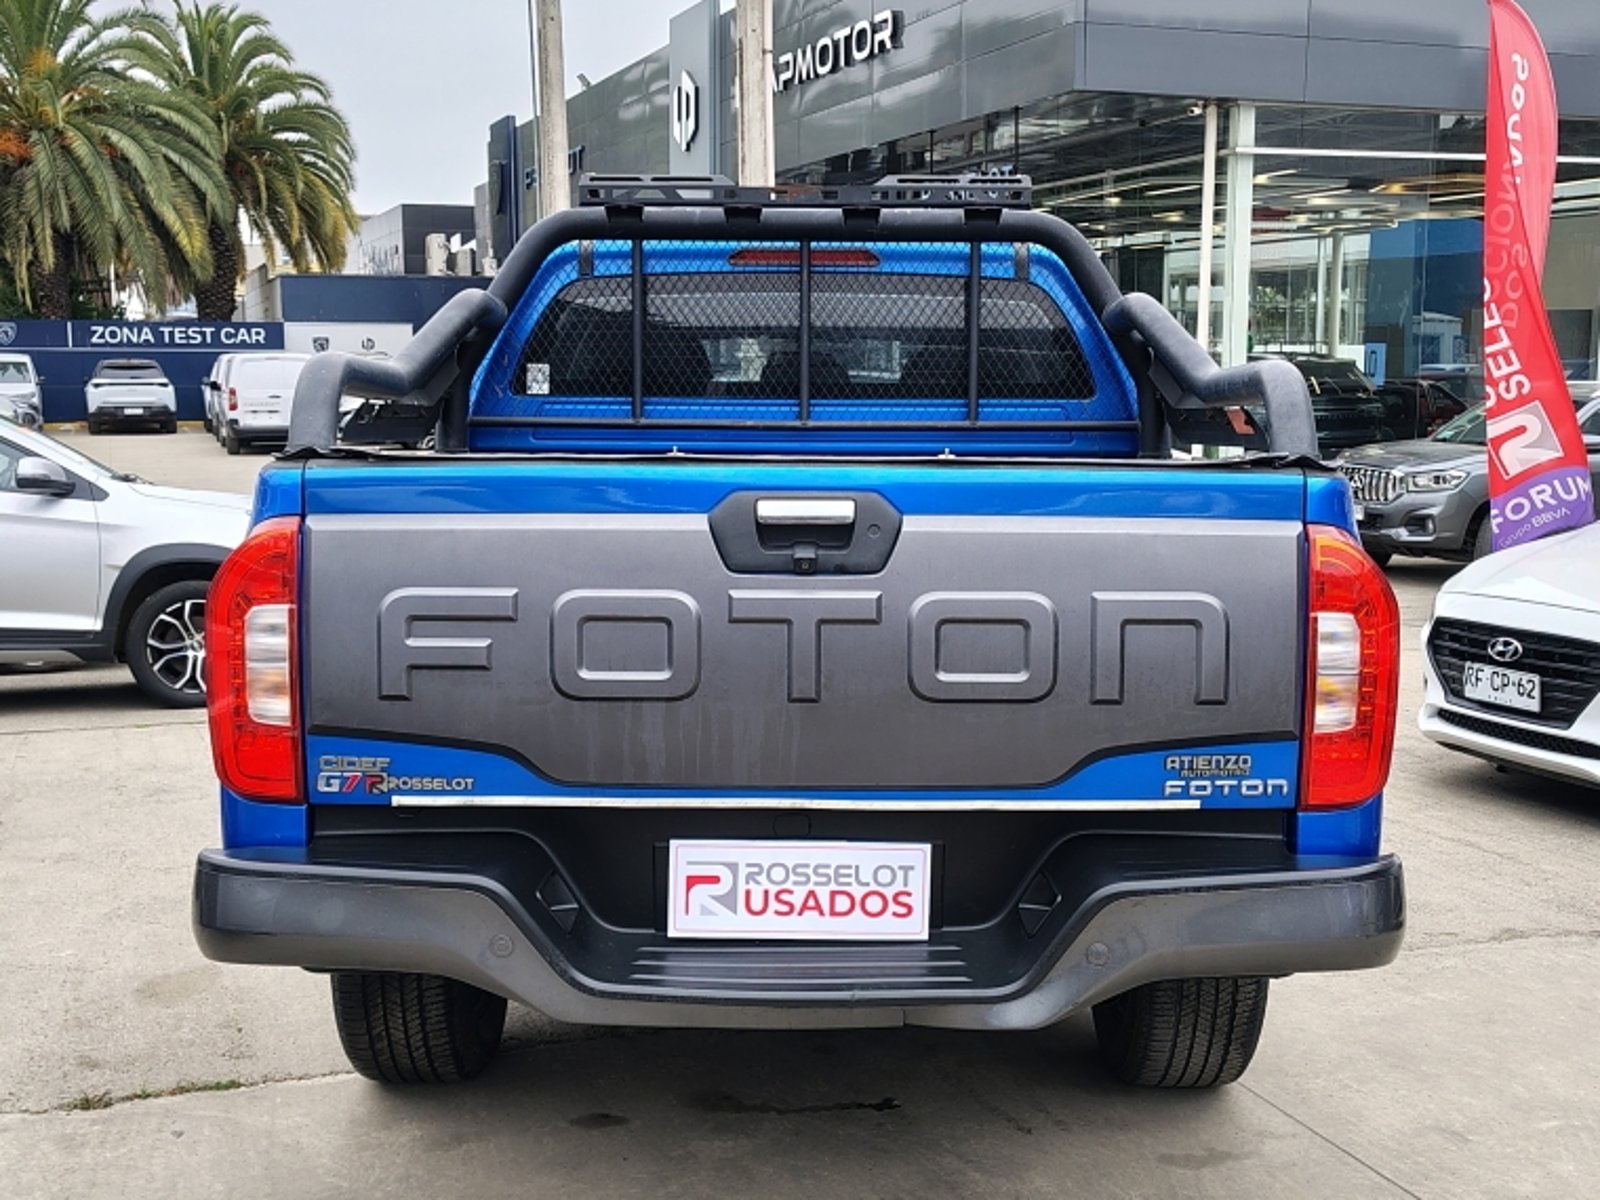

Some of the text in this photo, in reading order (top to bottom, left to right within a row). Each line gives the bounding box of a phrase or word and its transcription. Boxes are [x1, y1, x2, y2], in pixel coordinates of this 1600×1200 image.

[735, 8, 898, 106] PMOTOR
[90, 326, 266, 344] ZONA TEST CAR
[377, 586, 1230, 706] FOTON
[317, 772, 362, 792] G7
[388, 776, 474, 791] ROSSELOT
[1164, 778, 1288, 797] FOTON
[744, 862, 915, 888] ROSSELOT
[744, 888, 914, 918] USADOS
